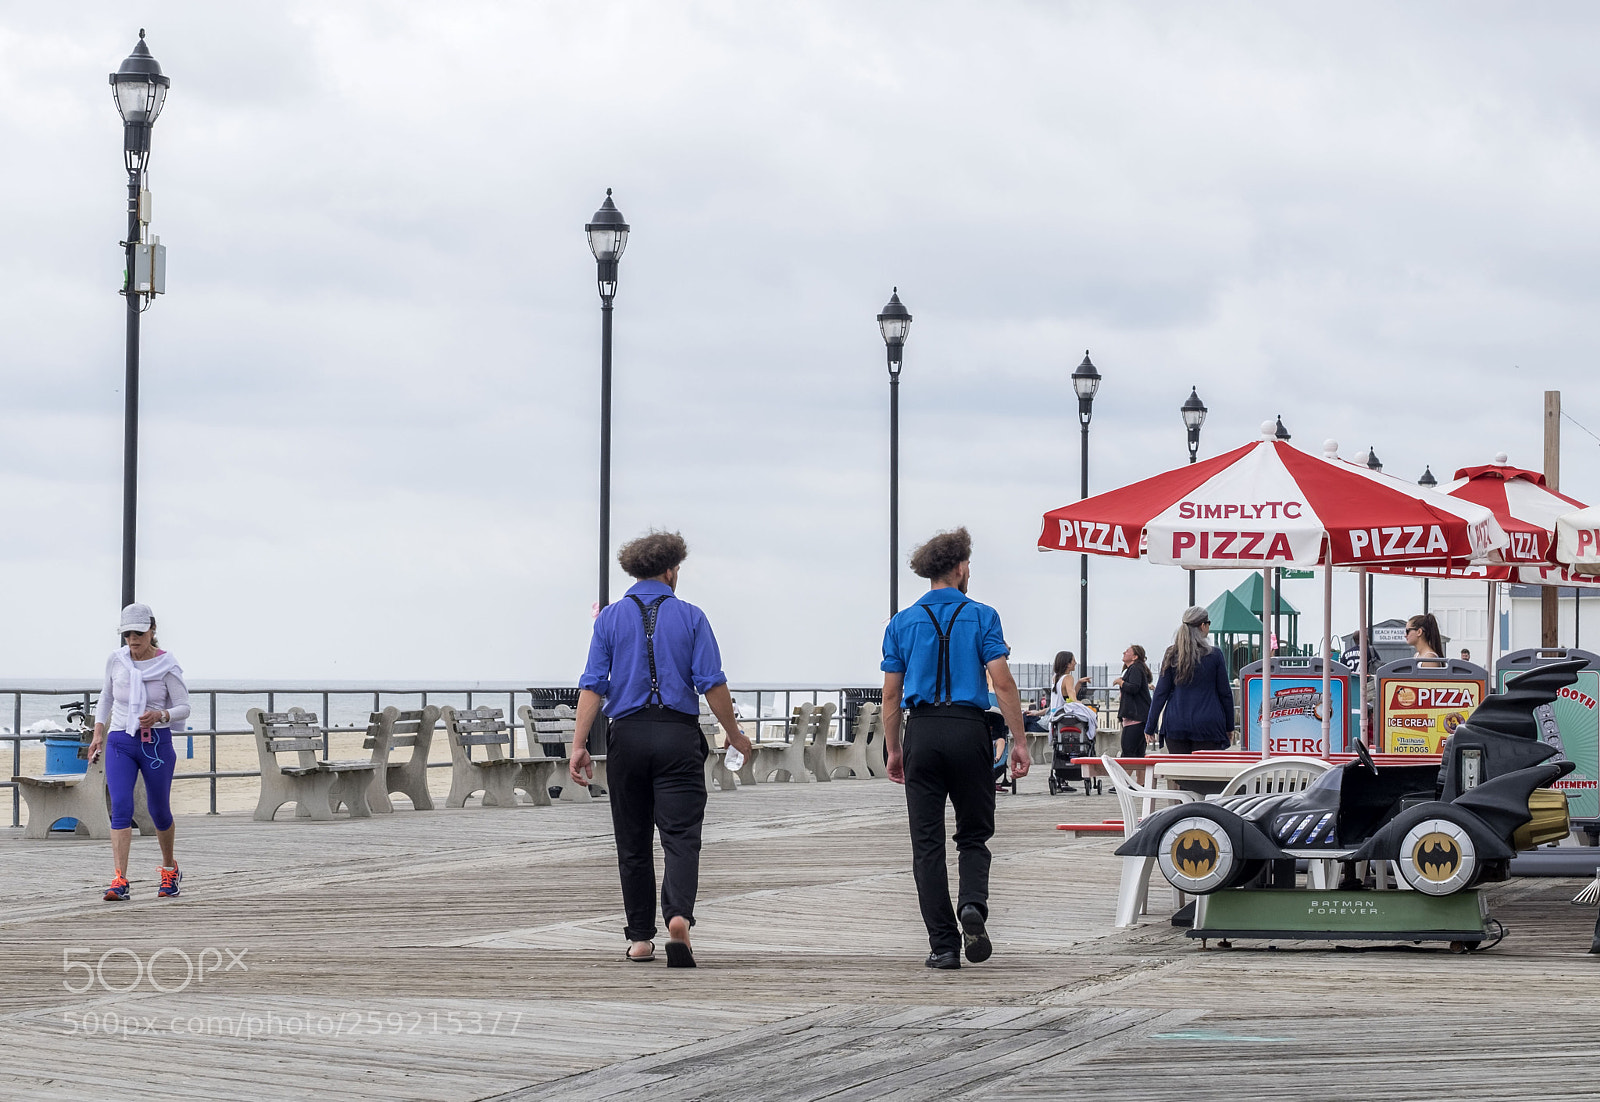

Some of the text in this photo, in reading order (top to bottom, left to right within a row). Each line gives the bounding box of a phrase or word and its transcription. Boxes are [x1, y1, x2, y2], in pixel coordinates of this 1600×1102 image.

[1058, 519, 1130, 554] PIZZA
[1172, 531, 1295, 561] PIZZA
[1349, 525, 1449, 558] PIZZA
[1505, 532, 1541, 560] IZZA
[1418, 688, 1474, 707] PIZZA
[1388, 718, 1435, 728] ICE CREAM
[1551, 780, 1598, 789] USEMENTS
